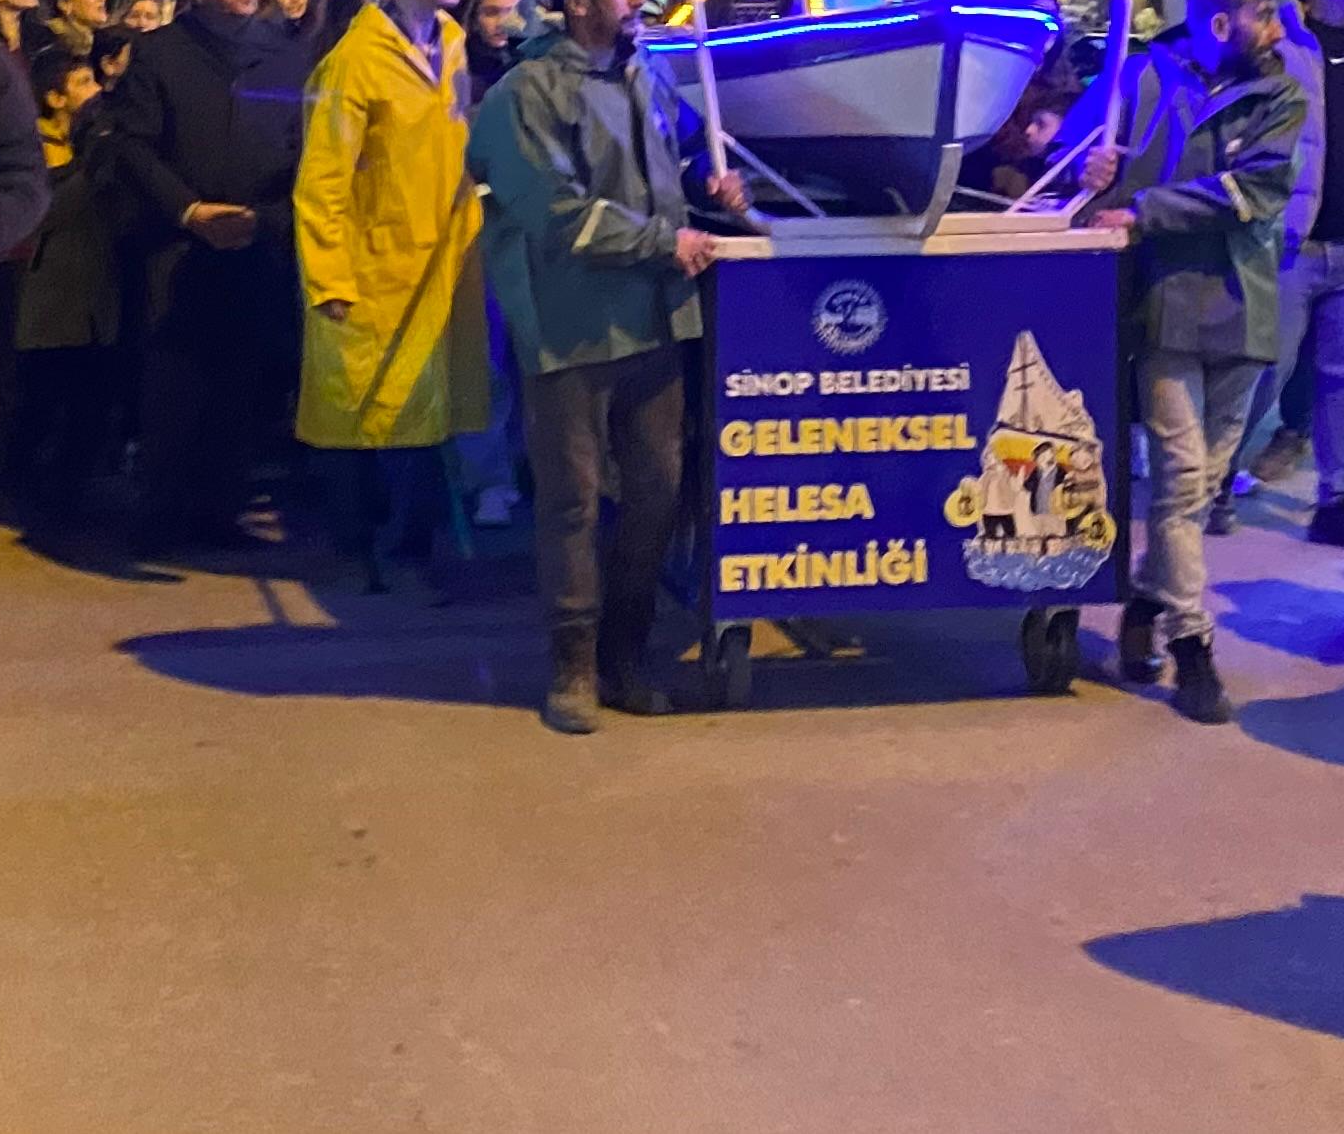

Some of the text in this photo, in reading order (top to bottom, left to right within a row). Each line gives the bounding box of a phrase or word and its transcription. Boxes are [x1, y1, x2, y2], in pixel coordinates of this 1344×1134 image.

[725, 362, 971, 397] SİNOP BELEDİYESİ
[719, 413, 978, 457] GELENEKSEL
[719, 482, 876, 526] HELESA
[719, 537, 929, 593] ETKİNLİĞİ
